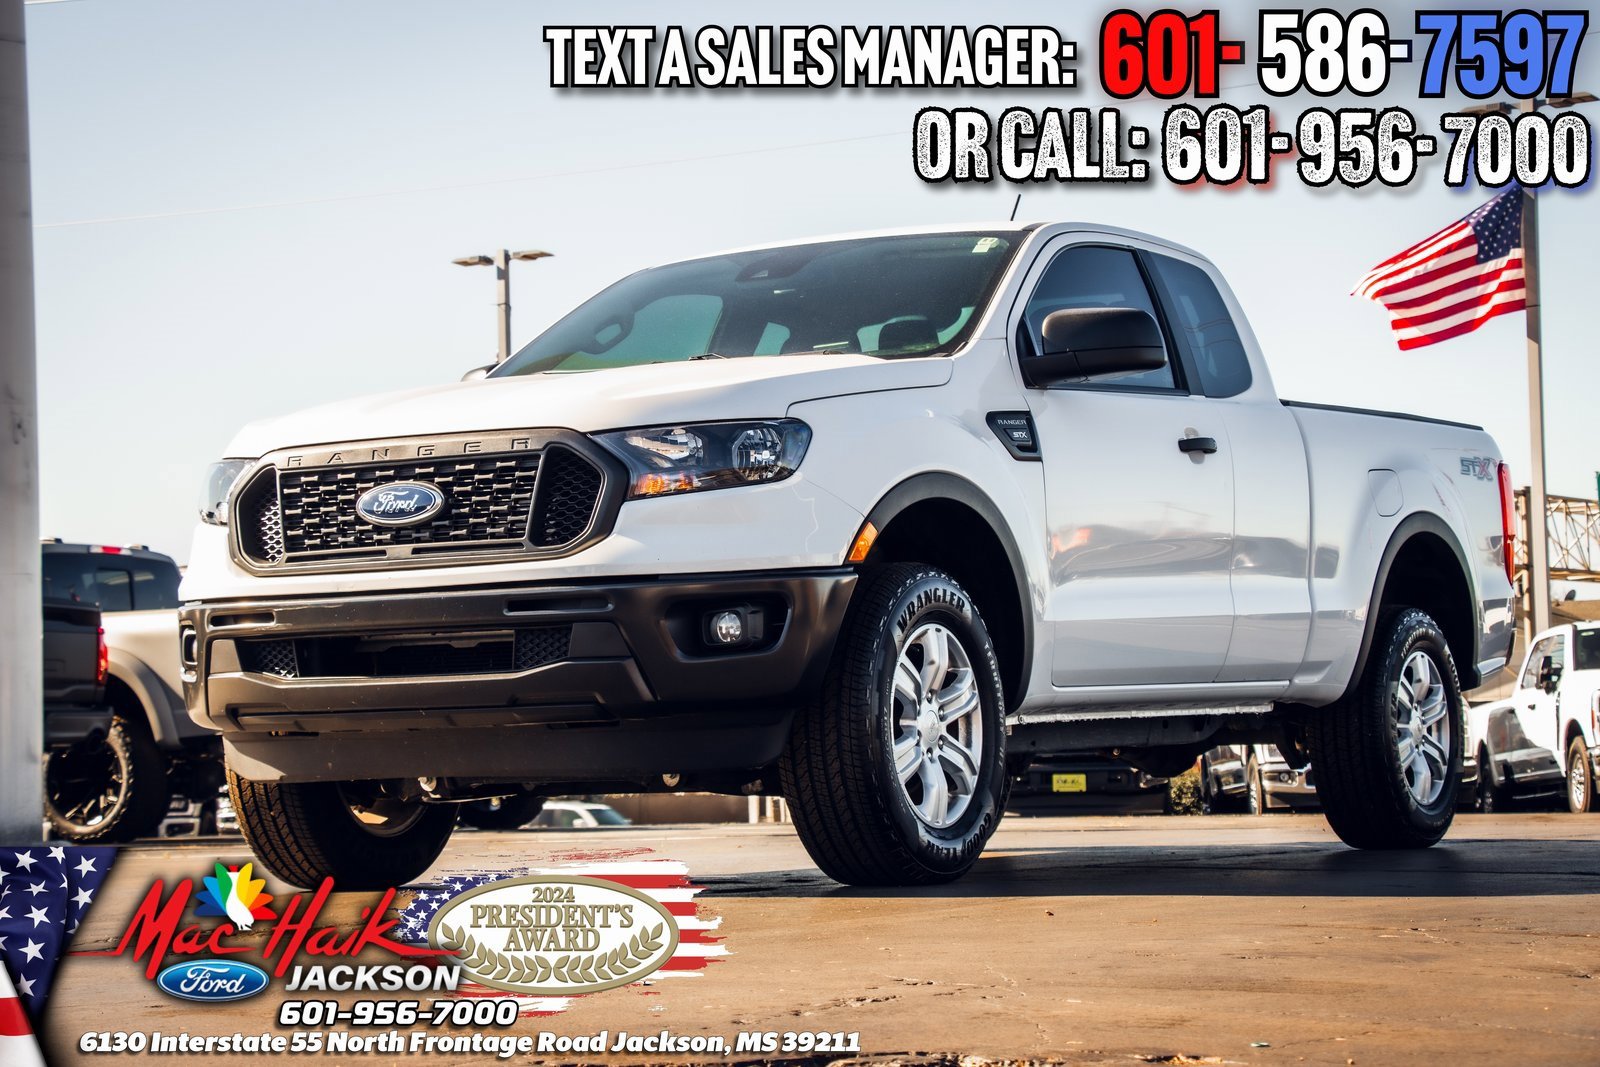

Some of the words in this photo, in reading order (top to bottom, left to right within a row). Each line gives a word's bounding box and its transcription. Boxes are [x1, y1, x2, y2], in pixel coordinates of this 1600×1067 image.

[287, 437, 531, 467] RANGER
[1460, 456, 1496, 481] STX
[373, 490, 420, 515] Ford
[897, 587, 966, 634] WRANGLER
